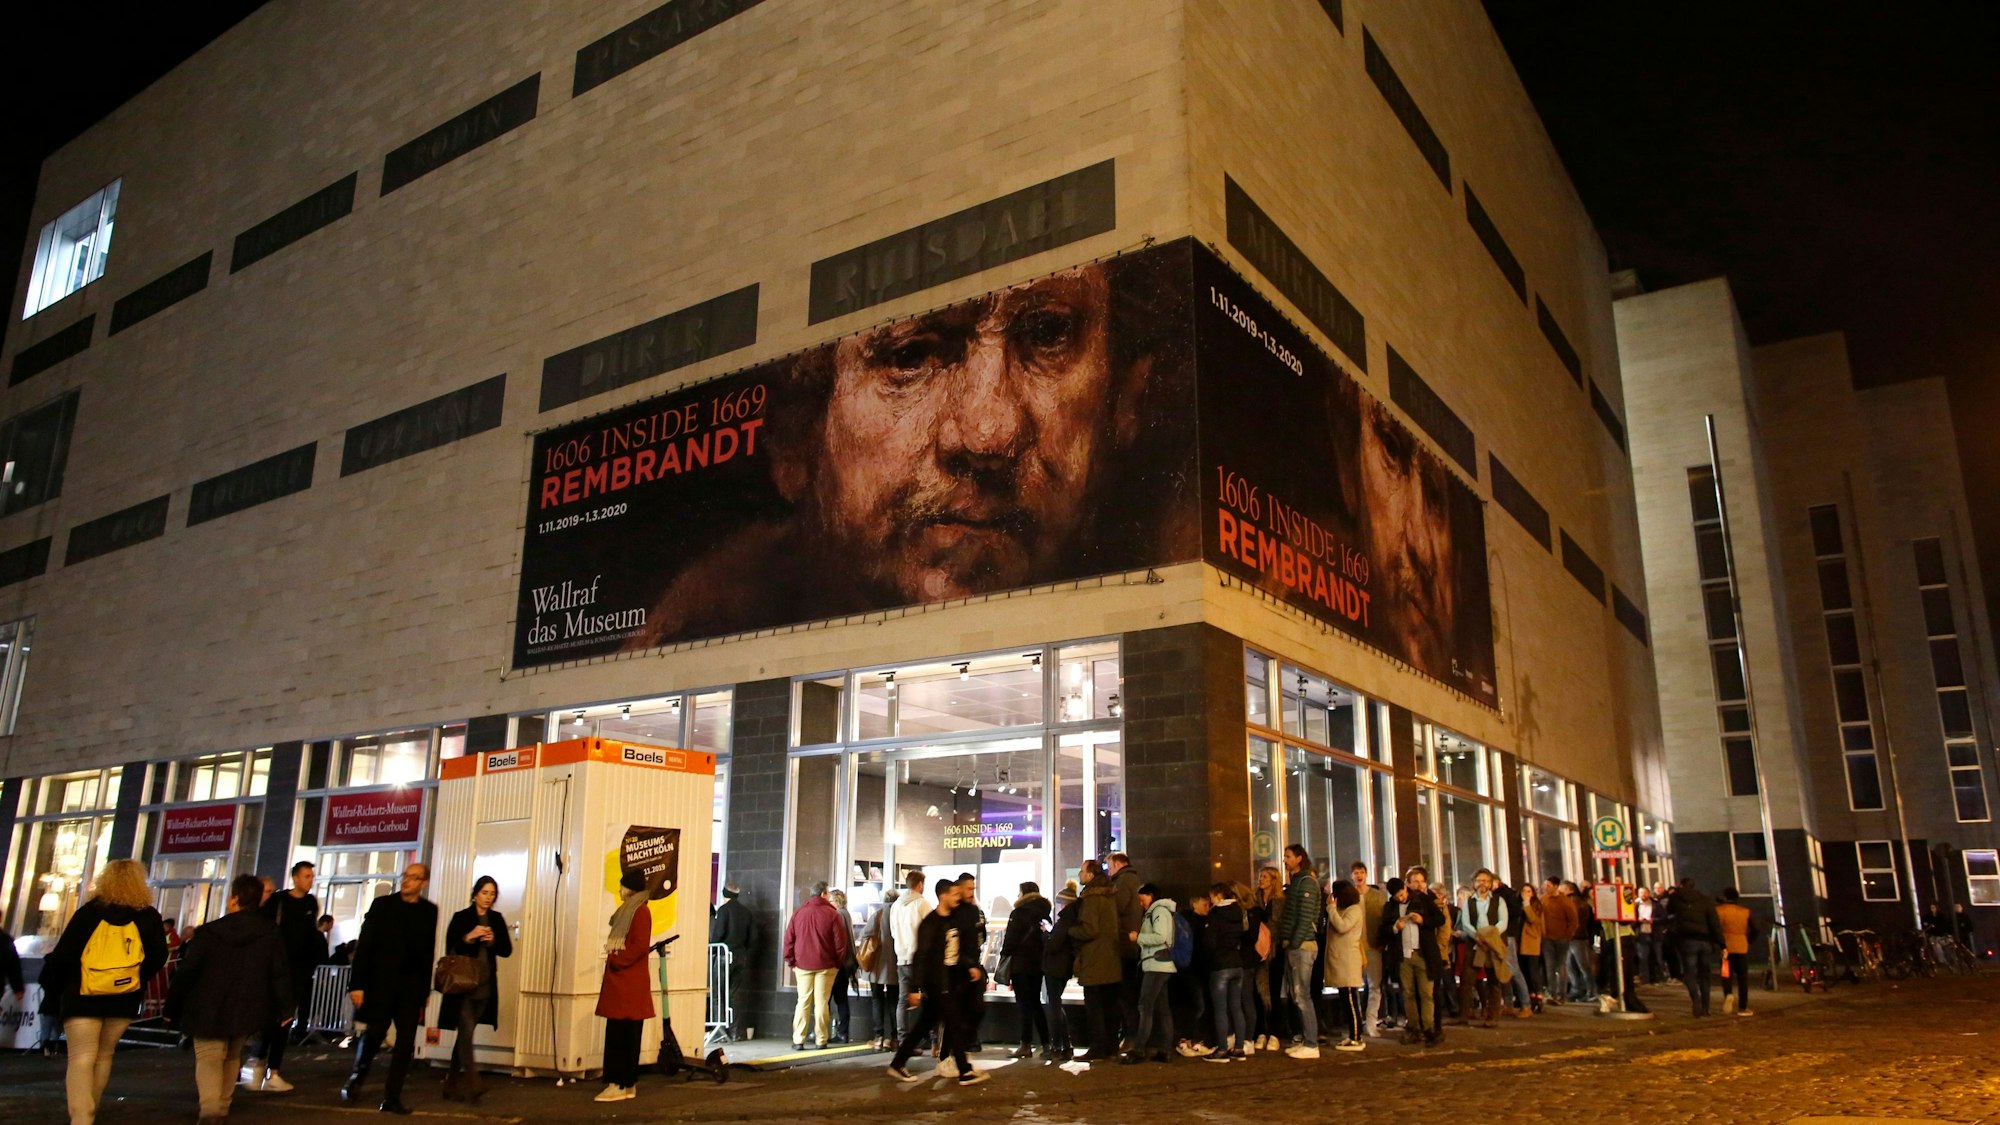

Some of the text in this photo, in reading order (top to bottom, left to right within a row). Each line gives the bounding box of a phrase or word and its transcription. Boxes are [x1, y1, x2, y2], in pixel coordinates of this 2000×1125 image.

[545, 384, 767, 474] 1606 INSIDE 1669
[540, 418, 764, 510] REMBRANDT
[1217, 465, 1370, 587] 1606 INSIDE 1669
[1218, 507, 1371, 628] REMBRANDT
[531, 574, 601, 615] Wallraf
[527, 607, 647, 645] das Museum
[488, 754, 517, 768] Boels
[624, 748, 664, 764] Boels
[332, 802, 418, 818] Wallraf-Richartz-Museum
[335, 819, 409, 835] & Fondation Corboud
[943, 822, 1013, 835] 1606 INSIDE 1669
[1601, 824, 1617, 843] H
[625, 835, 666, 854] MUSEUMS
[943, 835, 1014, 849] REMBRANDT
[626, 848, 653, 862] NACHT
[653, 842, 674, 856] KÖLN
[0, 1005, 35, 1032] ologne
